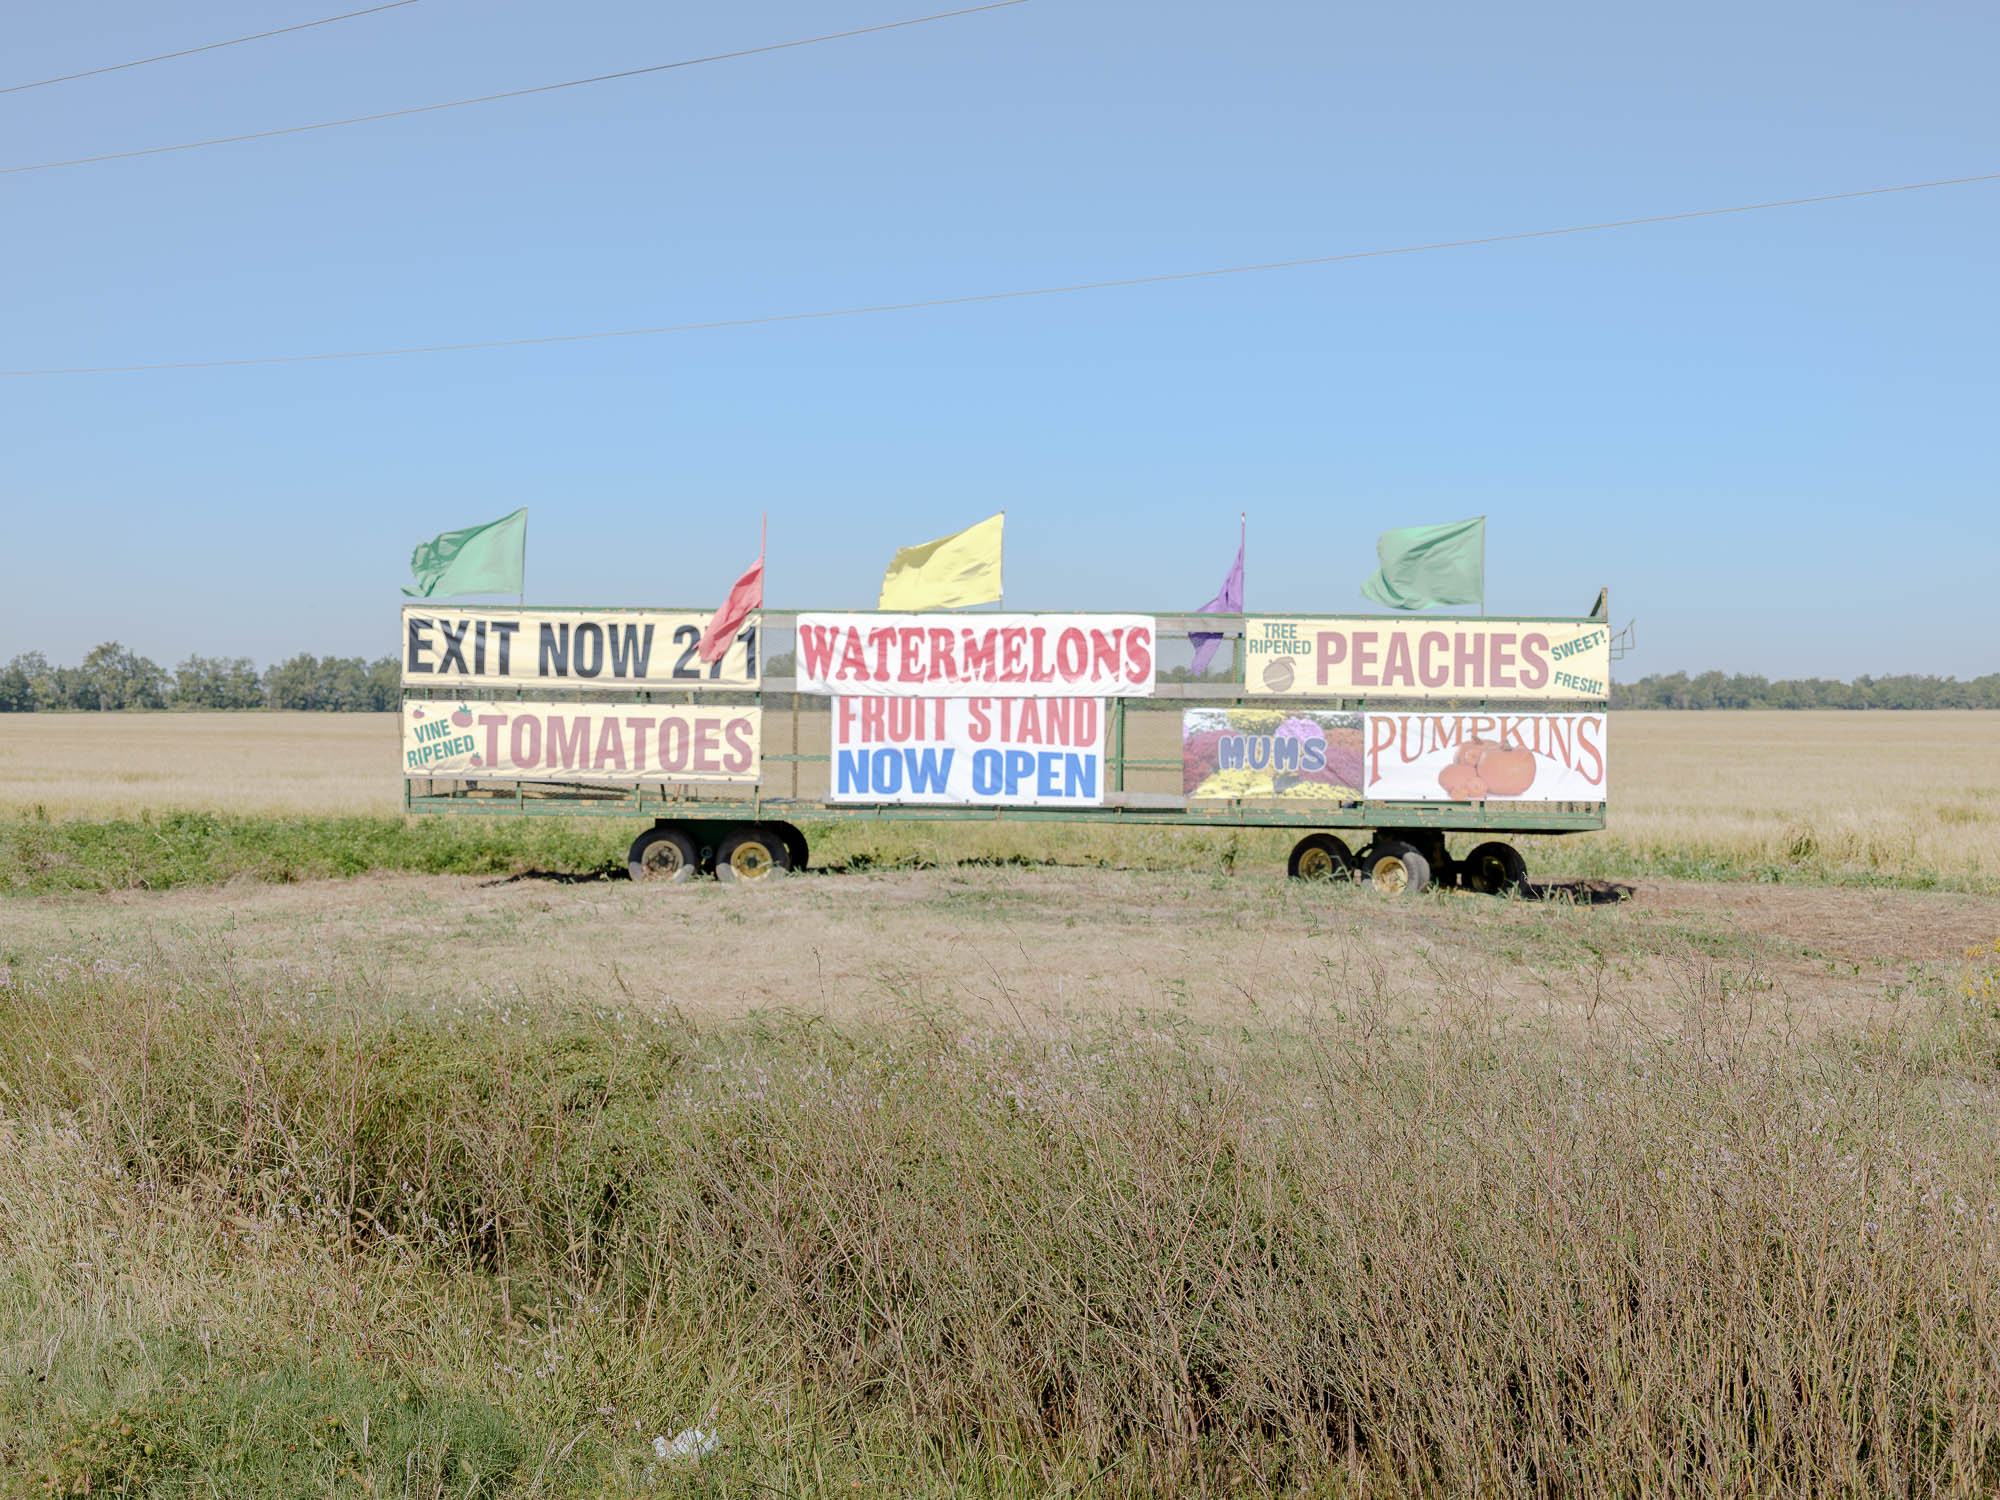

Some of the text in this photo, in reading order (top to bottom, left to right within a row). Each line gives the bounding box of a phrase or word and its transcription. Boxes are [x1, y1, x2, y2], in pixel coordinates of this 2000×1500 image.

[408, 618, 520, 675] EXIT
[539, 622, 655, 678] NOW
[1249, 640, 1311, 654] RIPENED
[1263, 623, 1298, 639] TREE
[1551, 630, 1606, 661] SWEET!
[799, 624, 1151, 684] WATERMELONS
[1316, 631, 1550, 689] PEACHES
[1554, 672, 1603, 695] FRESH!
[413, 718, 451, 743] VINE
[478, 714, 754, 773] TOMATOES
[838, 697, 1097, 747] FRUIT STAND
[407, 735, 474, 768] RIPENED
[837, 748, 1097, 798] NOW OPEN
[1218, 735, 1327, 771] MUMS
[1367, 716, 1603, 787] PUMPKINS
